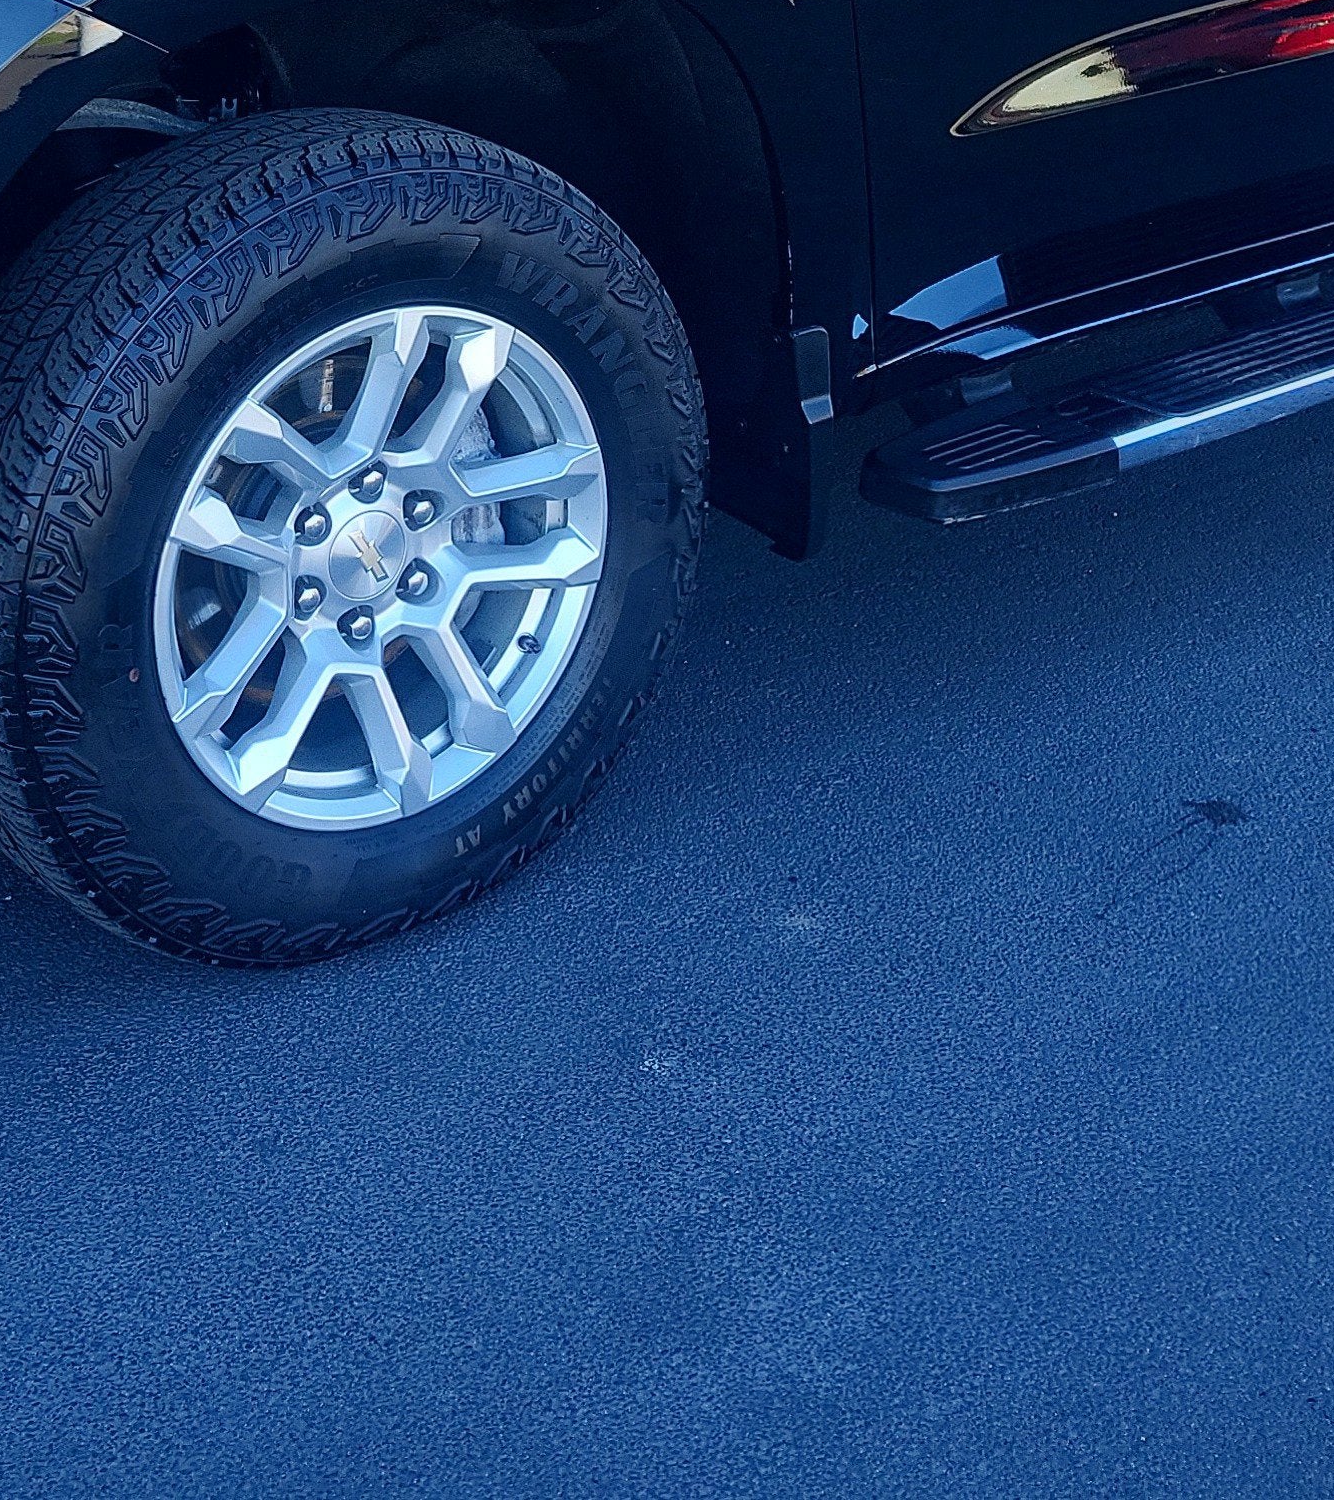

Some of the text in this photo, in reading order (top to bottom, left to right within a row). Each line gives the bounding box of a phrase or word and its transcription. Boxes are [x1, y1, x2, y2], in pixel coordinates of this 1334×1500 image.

[495, 251, 673, 526] WRANGLER
[454, 676, 613, 858] TERRITORY AT
